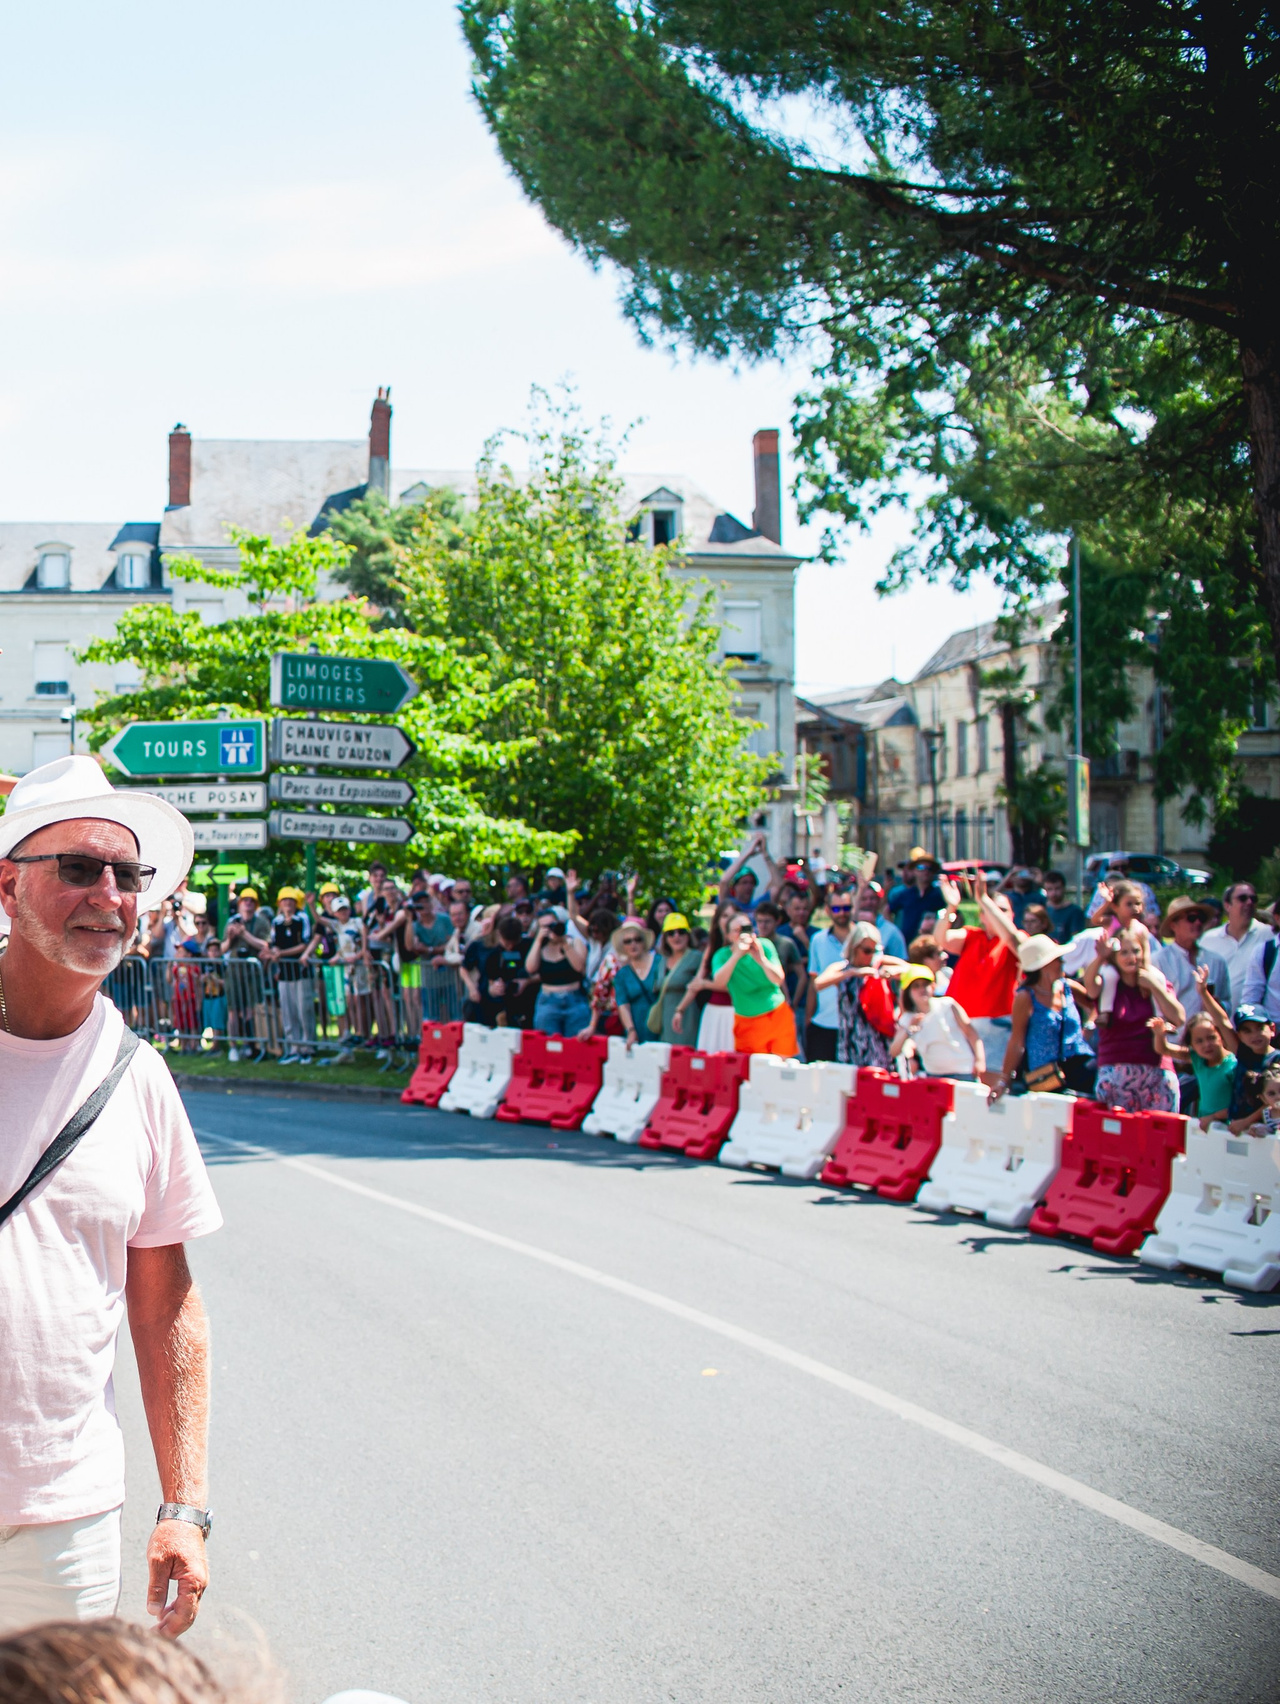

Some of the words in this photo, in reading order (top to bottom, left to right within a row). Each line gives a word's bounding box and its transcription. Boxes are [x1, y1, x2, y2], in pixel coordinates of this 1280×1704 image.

[287, 662, 364, 683] LIMOGES
[287, 683, 366, 704] POITIERS
[285, 726, 372, 743] CHAUVIGNY
[143, 740, 207, 758] TOURS
[284, 742, 331, 758] PLAINE
[337, 746, 392, 761] D'AUZON
[208, 790, 258, 804] POSAY
[284, 781, 310, 795] Parc
[314, 782, 335, 796] des
[338, 783, 402, 799] Expositions
[283, 818, 335, 836] Camping
[339, 821, 355, 835] du
